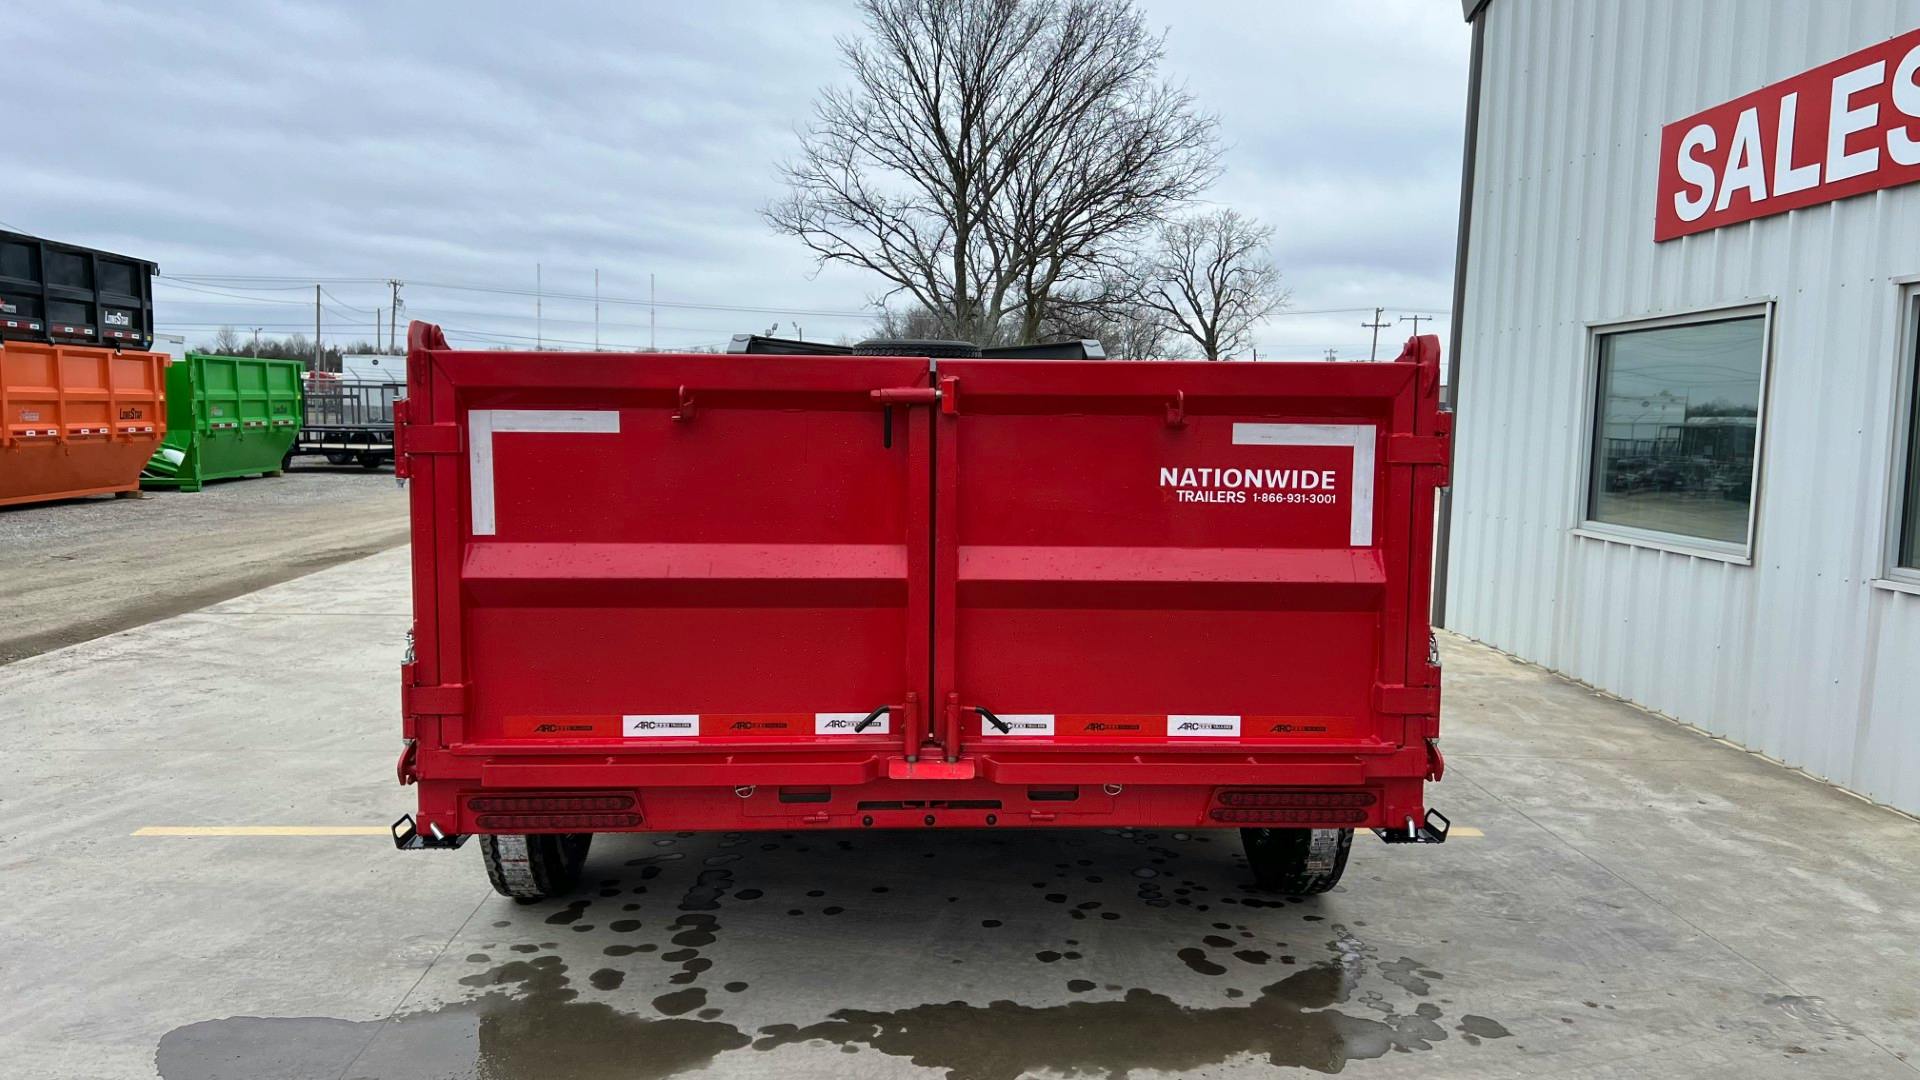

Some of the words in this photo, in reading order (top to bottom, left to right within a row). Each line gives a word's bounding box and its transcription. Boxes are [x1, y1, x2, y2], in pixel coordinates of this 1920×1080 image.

[1159, 467, 1336, 490] NATIONWIDE
[1176, 490, 1246, 503] TRAILERS
[1253, 493, 1336, 504] 1-866-931-3001
